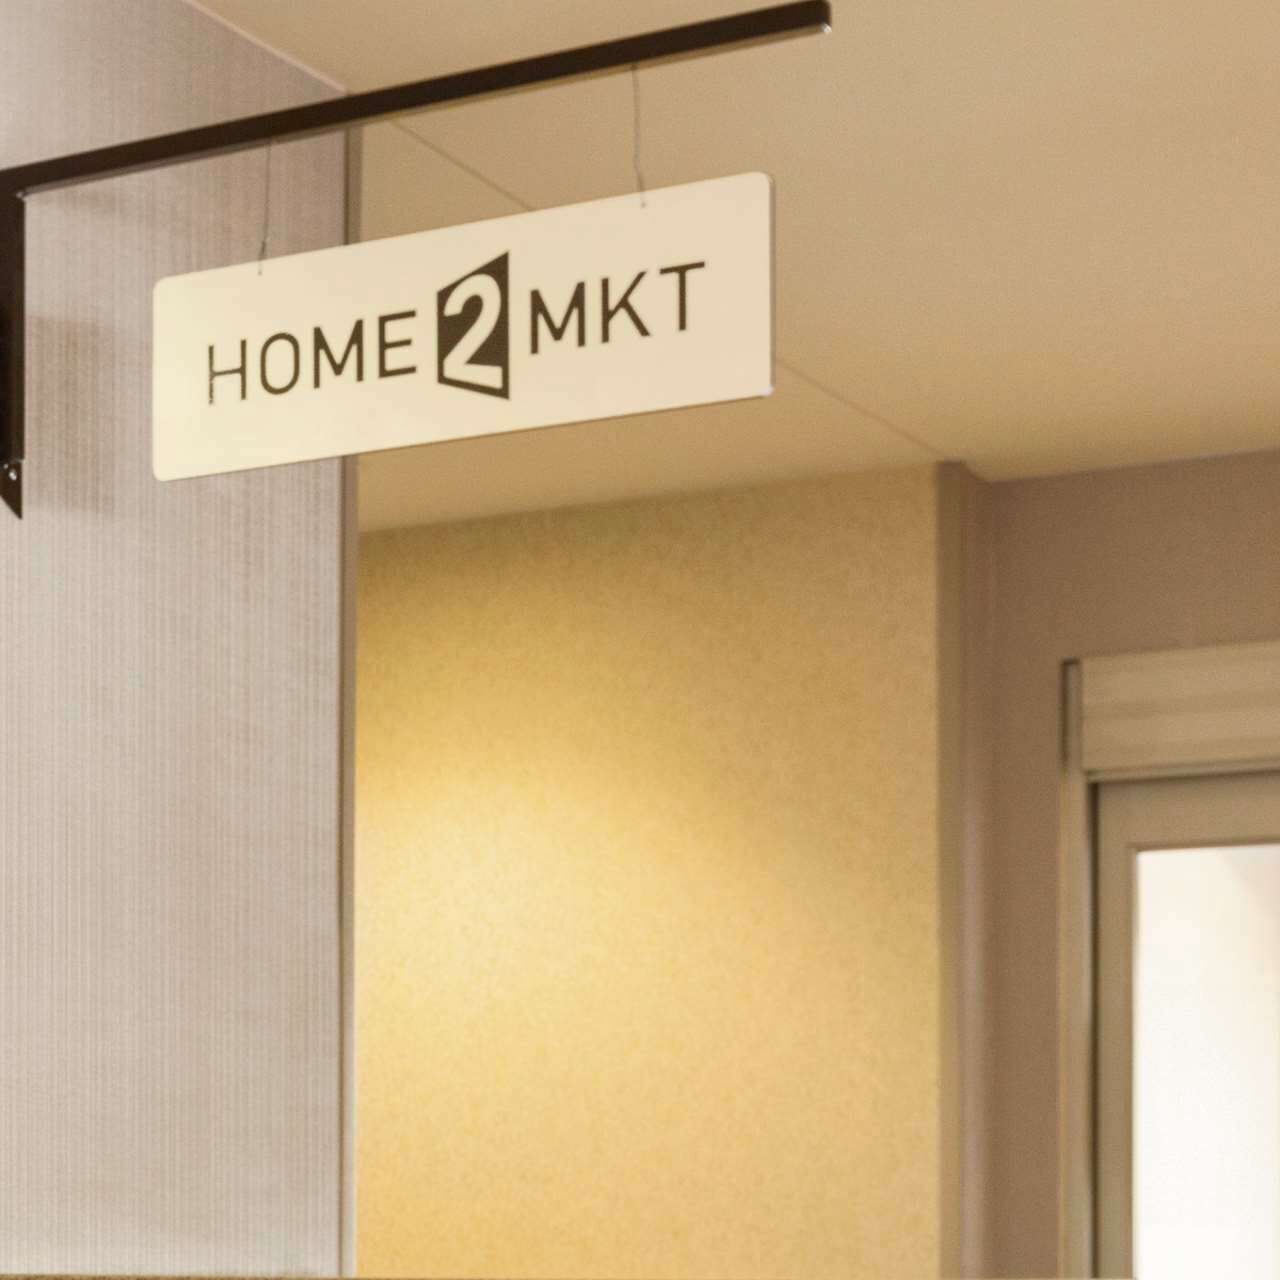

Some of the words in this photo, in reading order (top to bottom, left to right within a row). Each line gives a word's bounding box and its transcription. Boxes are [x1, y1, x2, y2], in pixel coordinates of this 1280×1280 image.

[207, 309, 418, 405] HOME
[440, 270, 504, 392] 2
[529, 260, 707, 356] MKT
